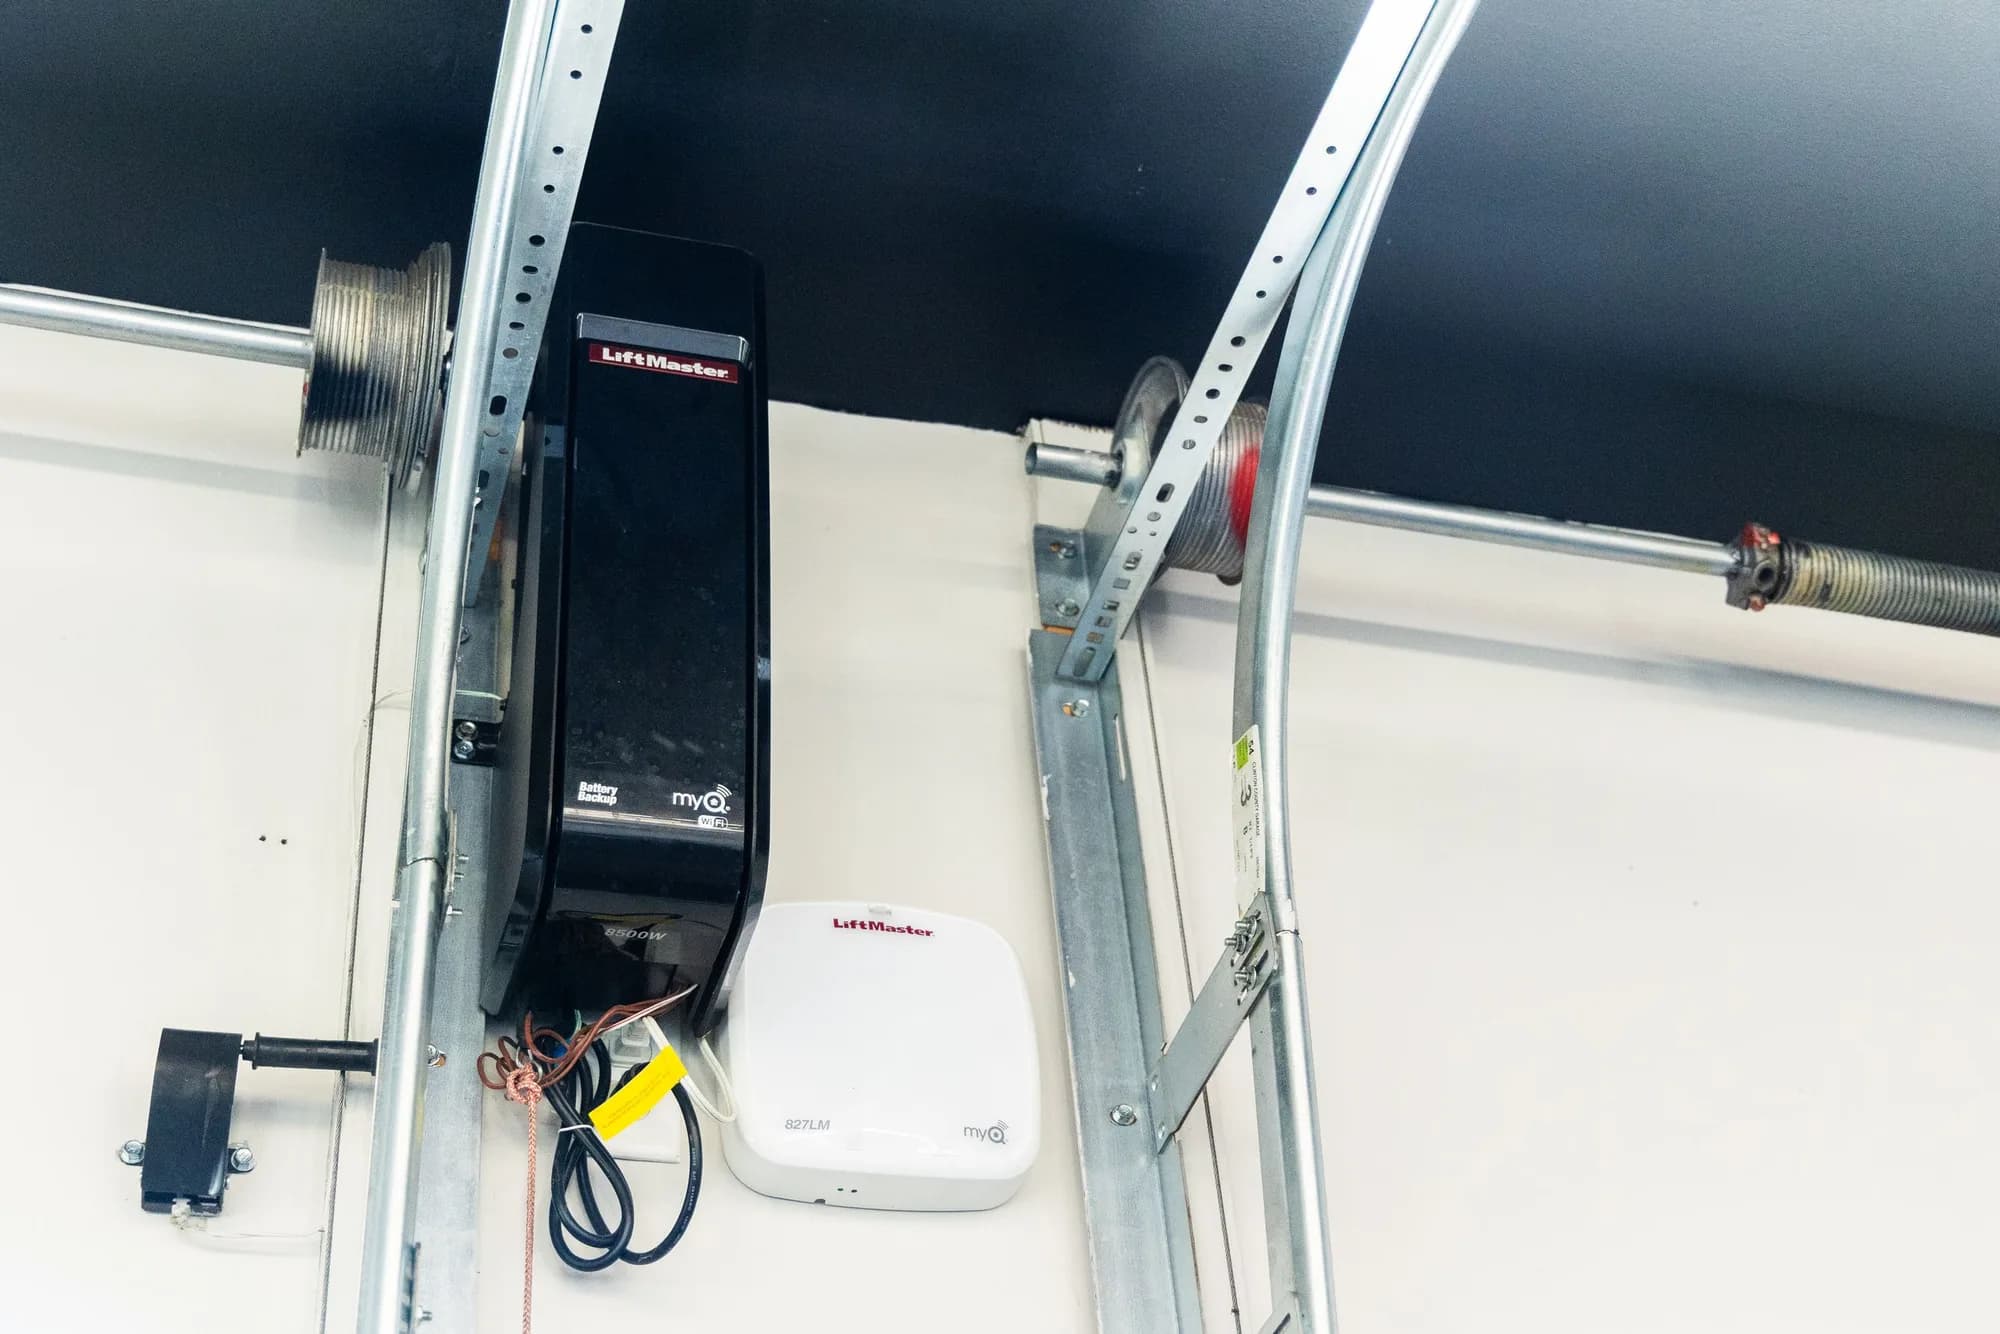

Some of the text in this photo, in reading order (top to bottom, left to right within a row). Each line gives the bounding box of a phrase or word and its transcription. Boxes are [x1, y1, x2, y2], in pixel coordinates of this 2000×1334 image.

[602, 347, 728, 378] LiftMaster
[577, 791, 618, 806] Backup
[579, 781, 618, 797] Battery
[1240, 783, 1252, 807] 3
[672, 790, 729, 814] myQ
[604, 928, 668, 940] 8500W
[832, 918, 934, 937] LiftMaster
[784, 1119, 831, 1130] 827LM
[963, 1125, 1007, 1144] myQ
